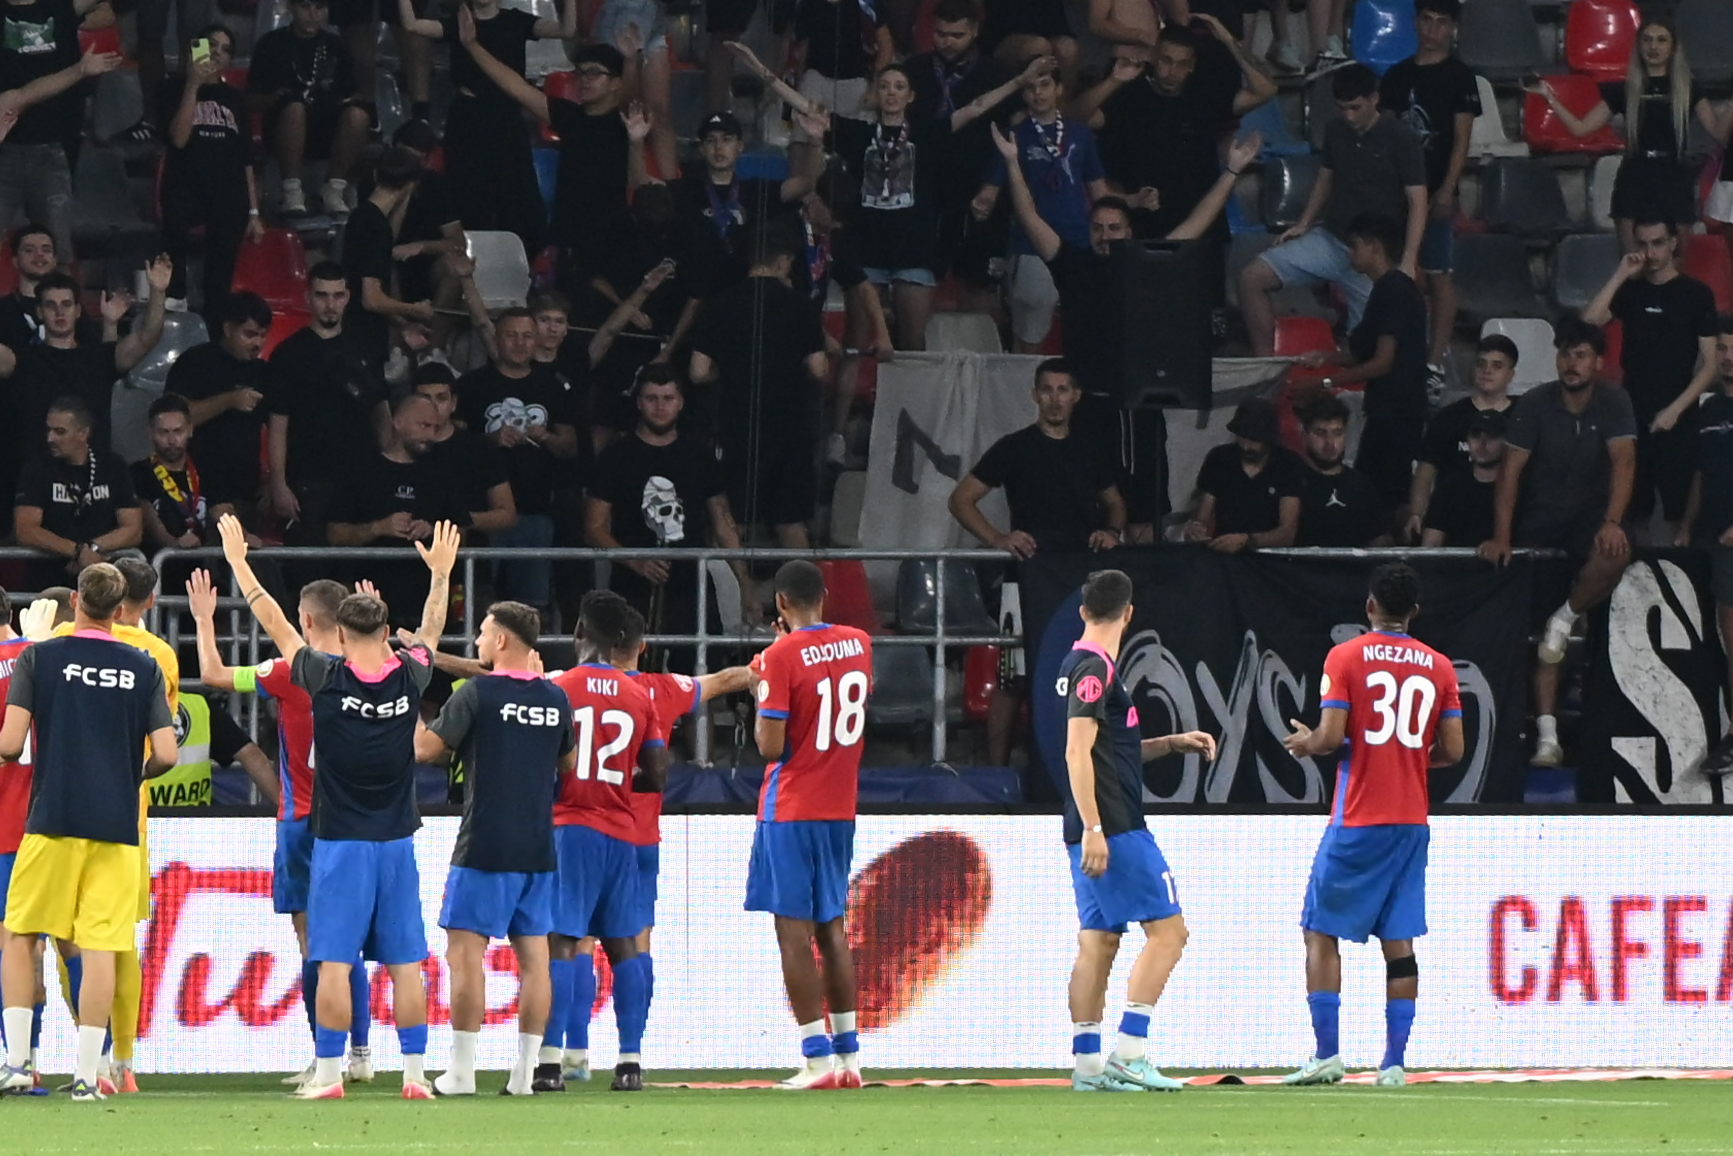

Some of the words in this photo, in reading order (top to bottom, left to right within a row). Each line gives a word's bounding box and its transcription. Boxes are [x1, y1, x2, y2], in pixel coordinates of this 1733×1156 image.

[801, 639, 864, 667] EDJOUMA
[1363, 645, 1434, 670] NGEZANA
[63, 663, 136, 690] FCSB
[587, 677, 618, 697] KIKI
[341, 696, 411, 720] FCSB
[500, 703, 561, 727] FCSB
[817, 670, 868, 752] 18
[1364, 670, 1436, 749] 30
[571, 706, 634, 785] 12
[148, 778, 209, 806] WARD
